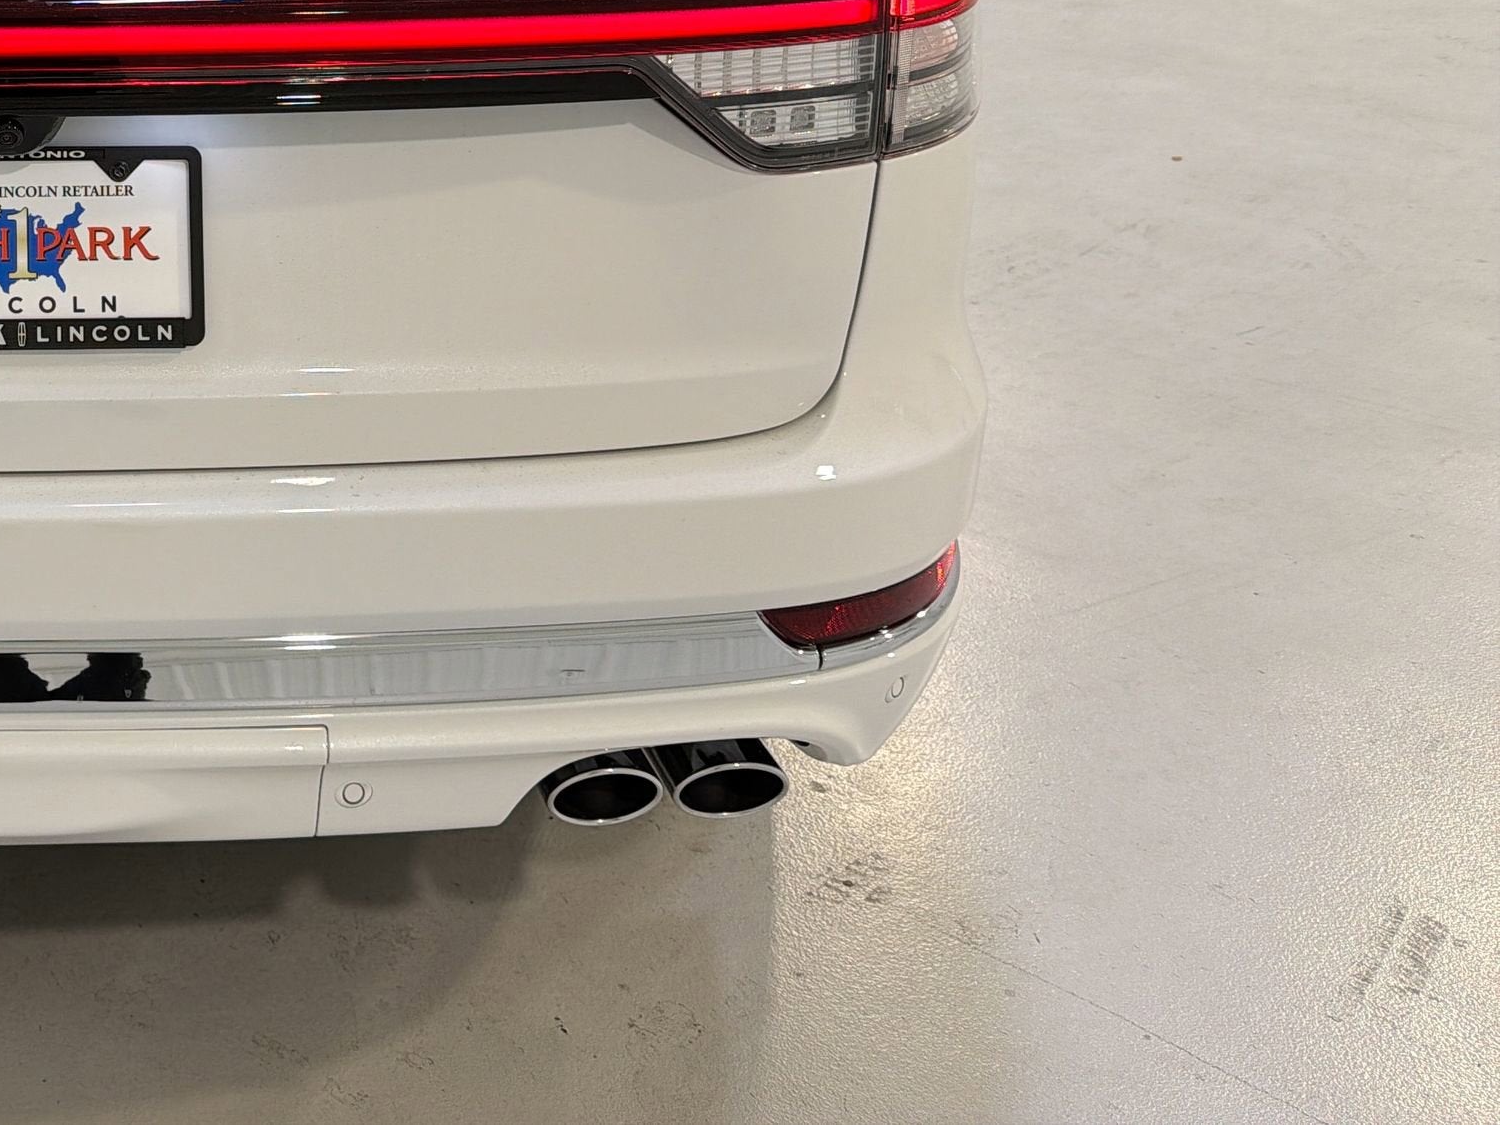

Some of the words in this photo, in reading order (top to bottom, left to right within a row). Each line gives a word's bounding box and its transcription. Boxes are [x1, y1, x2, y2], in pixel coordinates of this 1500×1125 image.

[62, 184, 135, 198] RETAILER
[36, 226, 161, 261] PARK
[36, 324, 173, 343] LINCOLN
